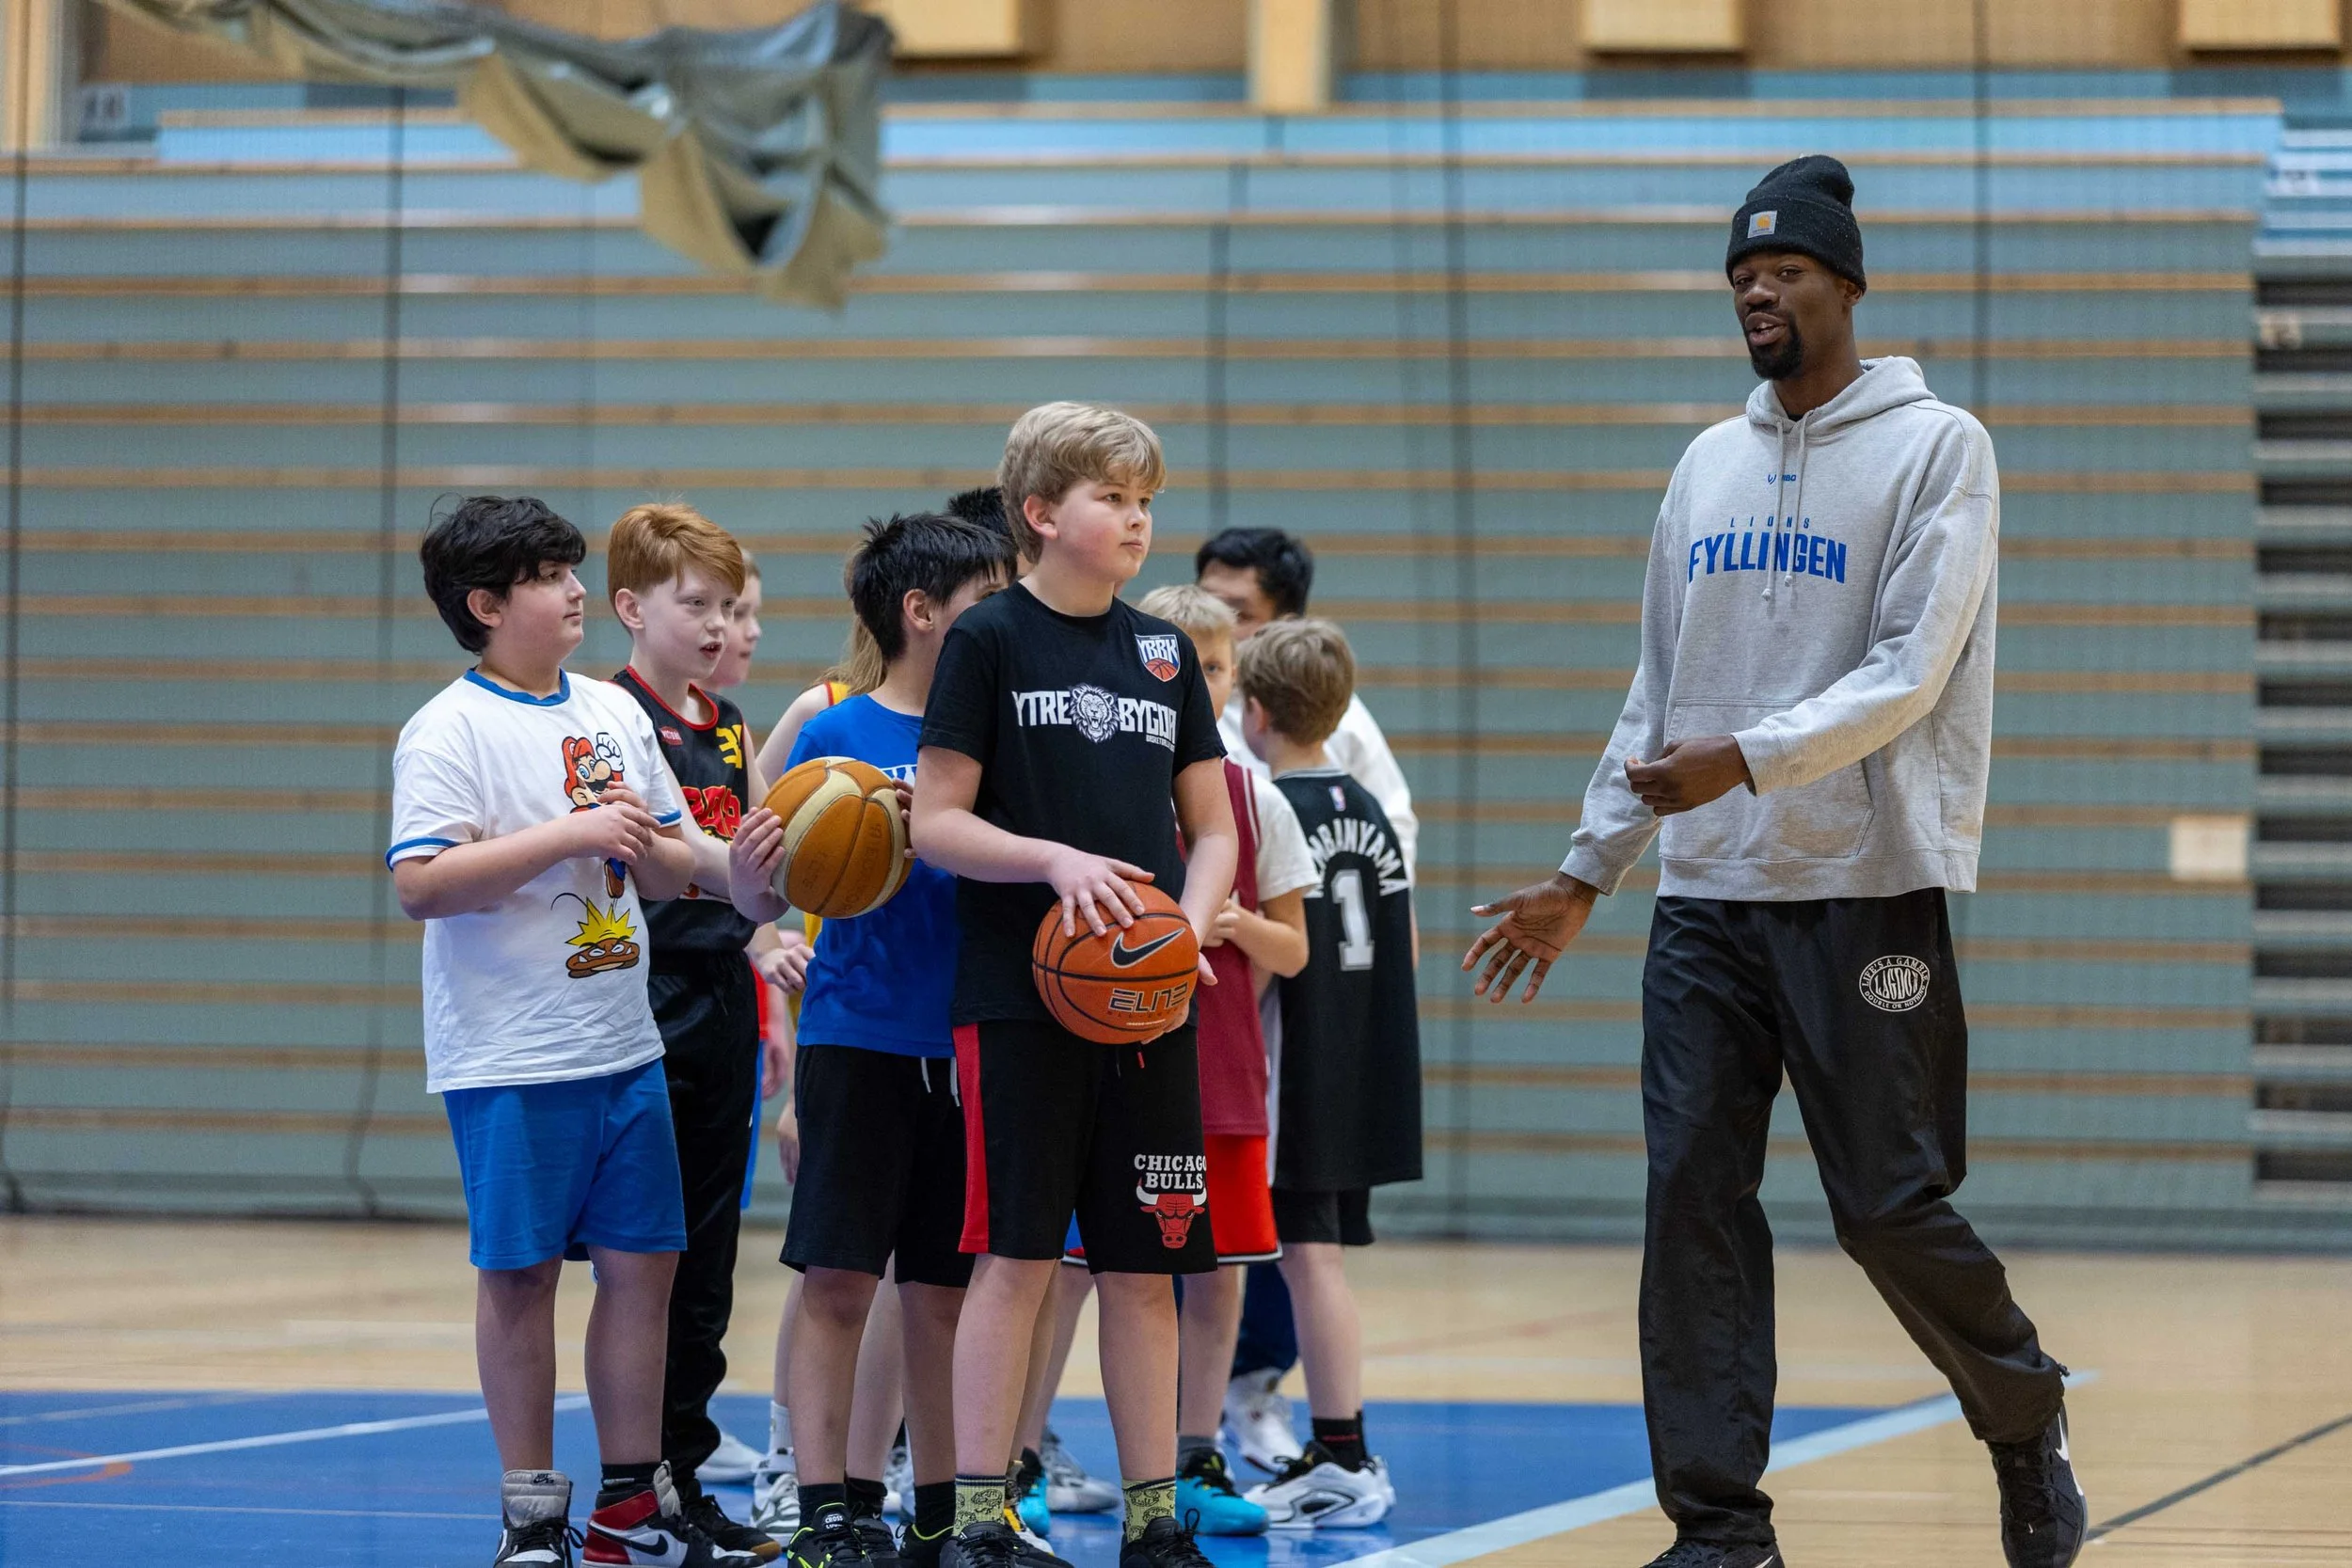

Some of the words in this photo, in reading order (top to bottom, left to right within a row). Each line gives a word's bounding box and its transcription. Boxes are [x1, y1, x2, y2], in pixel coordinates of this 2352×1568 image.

[1730, 516, 1810, 529] LIONS
[1688, 531, 1847, 584] FYLLINGEN
[1136, 639, 1179, 664] YBBK
[1011, 690, 1073, 727] YTRE
[1330, 869, 1375, 971] 1
[1862, 960, 1883, 987] LIFE'S
[1886, 958, 1892, 966] A
[1897, 958, 1929, 982] GAMBLE
[1108, 980, 1189, 1012] ELITE
[1865, 990, 1889, 1008] DOUBLE
[1904, 986, 1926, 1007] NOTHING
[1145, 1172, 1203, 1190] BULLS
